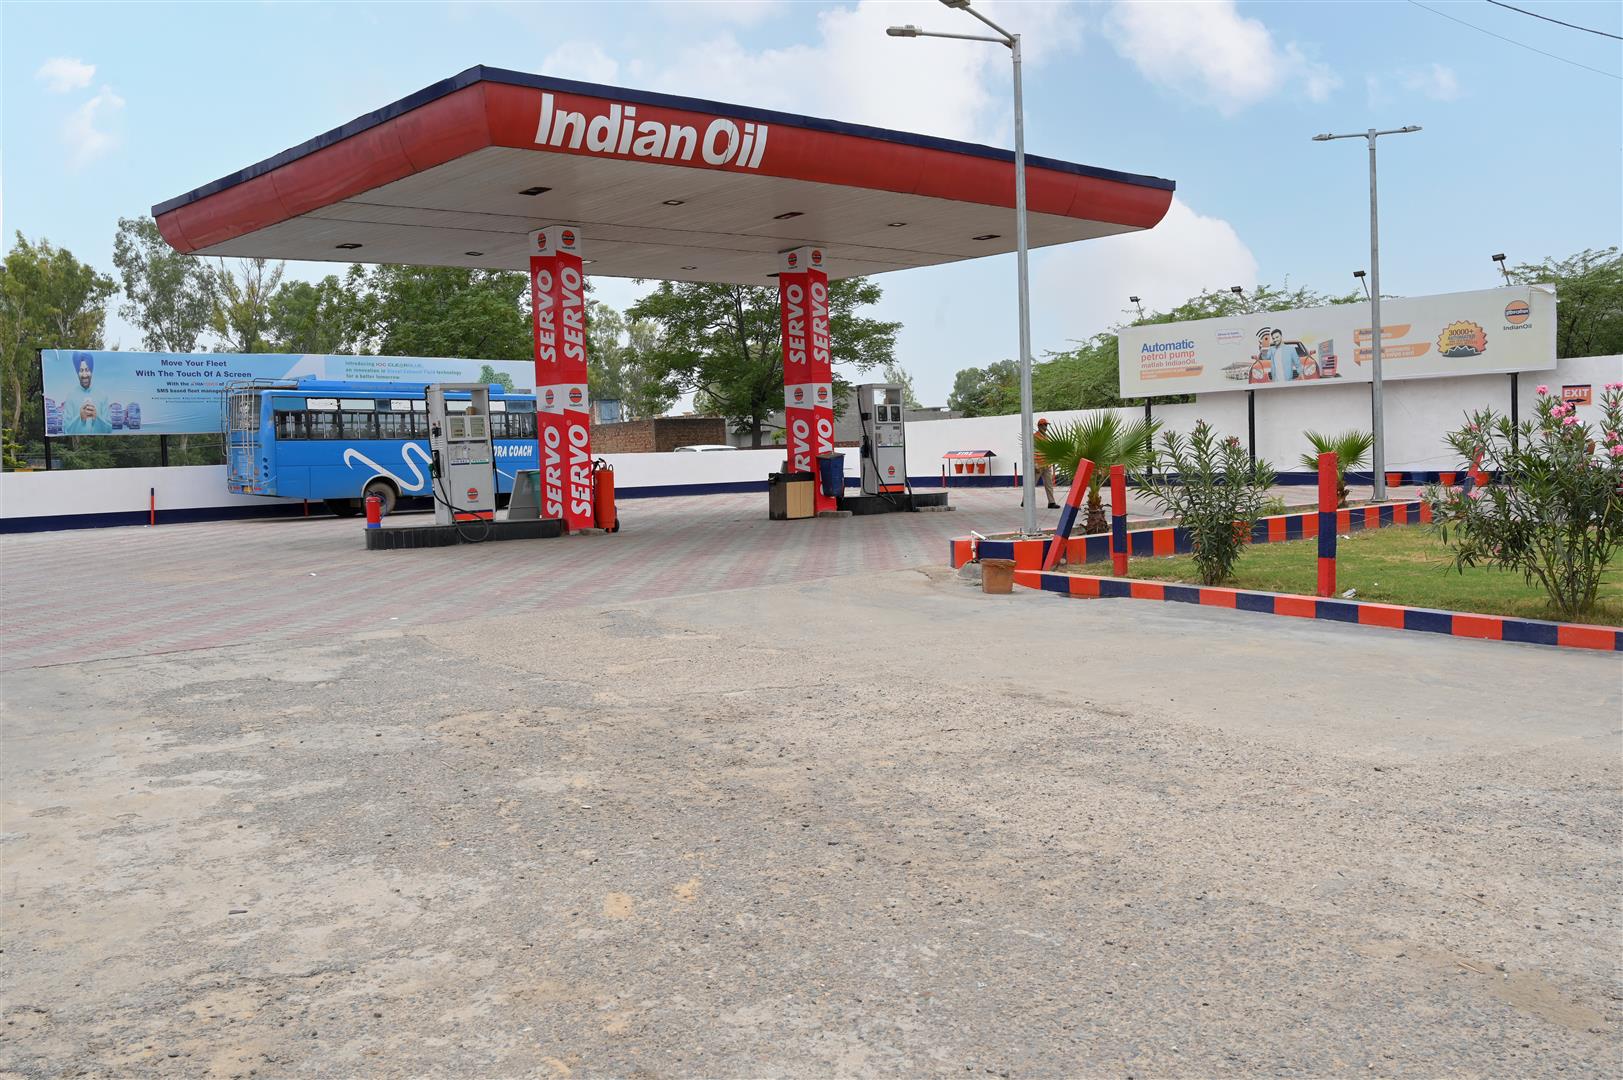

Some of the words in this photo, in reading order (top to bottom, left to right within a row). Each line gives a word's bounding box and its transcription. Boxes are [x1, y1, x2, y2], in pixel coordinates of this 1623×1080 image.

[537, 269, 556, 362] SERVO
[560, 267, 584, 362] SERVO
[787, 284, 806, 365] SERVO
[811, 282, 829, 364] SERVO
[1141, 339, 1195, 353] Automatic
[1141, 351, 1167, 362] petrol
[1169, 350, 1195, 361] pump
[1141, 361, 1163, 369] matlab
[1564, 389, 1589, 397] EXIT
[509, 445, 533, 456] COACH
[544, 426, 563, 518] SERVO
[568, 424, 591, 517] SERVO
